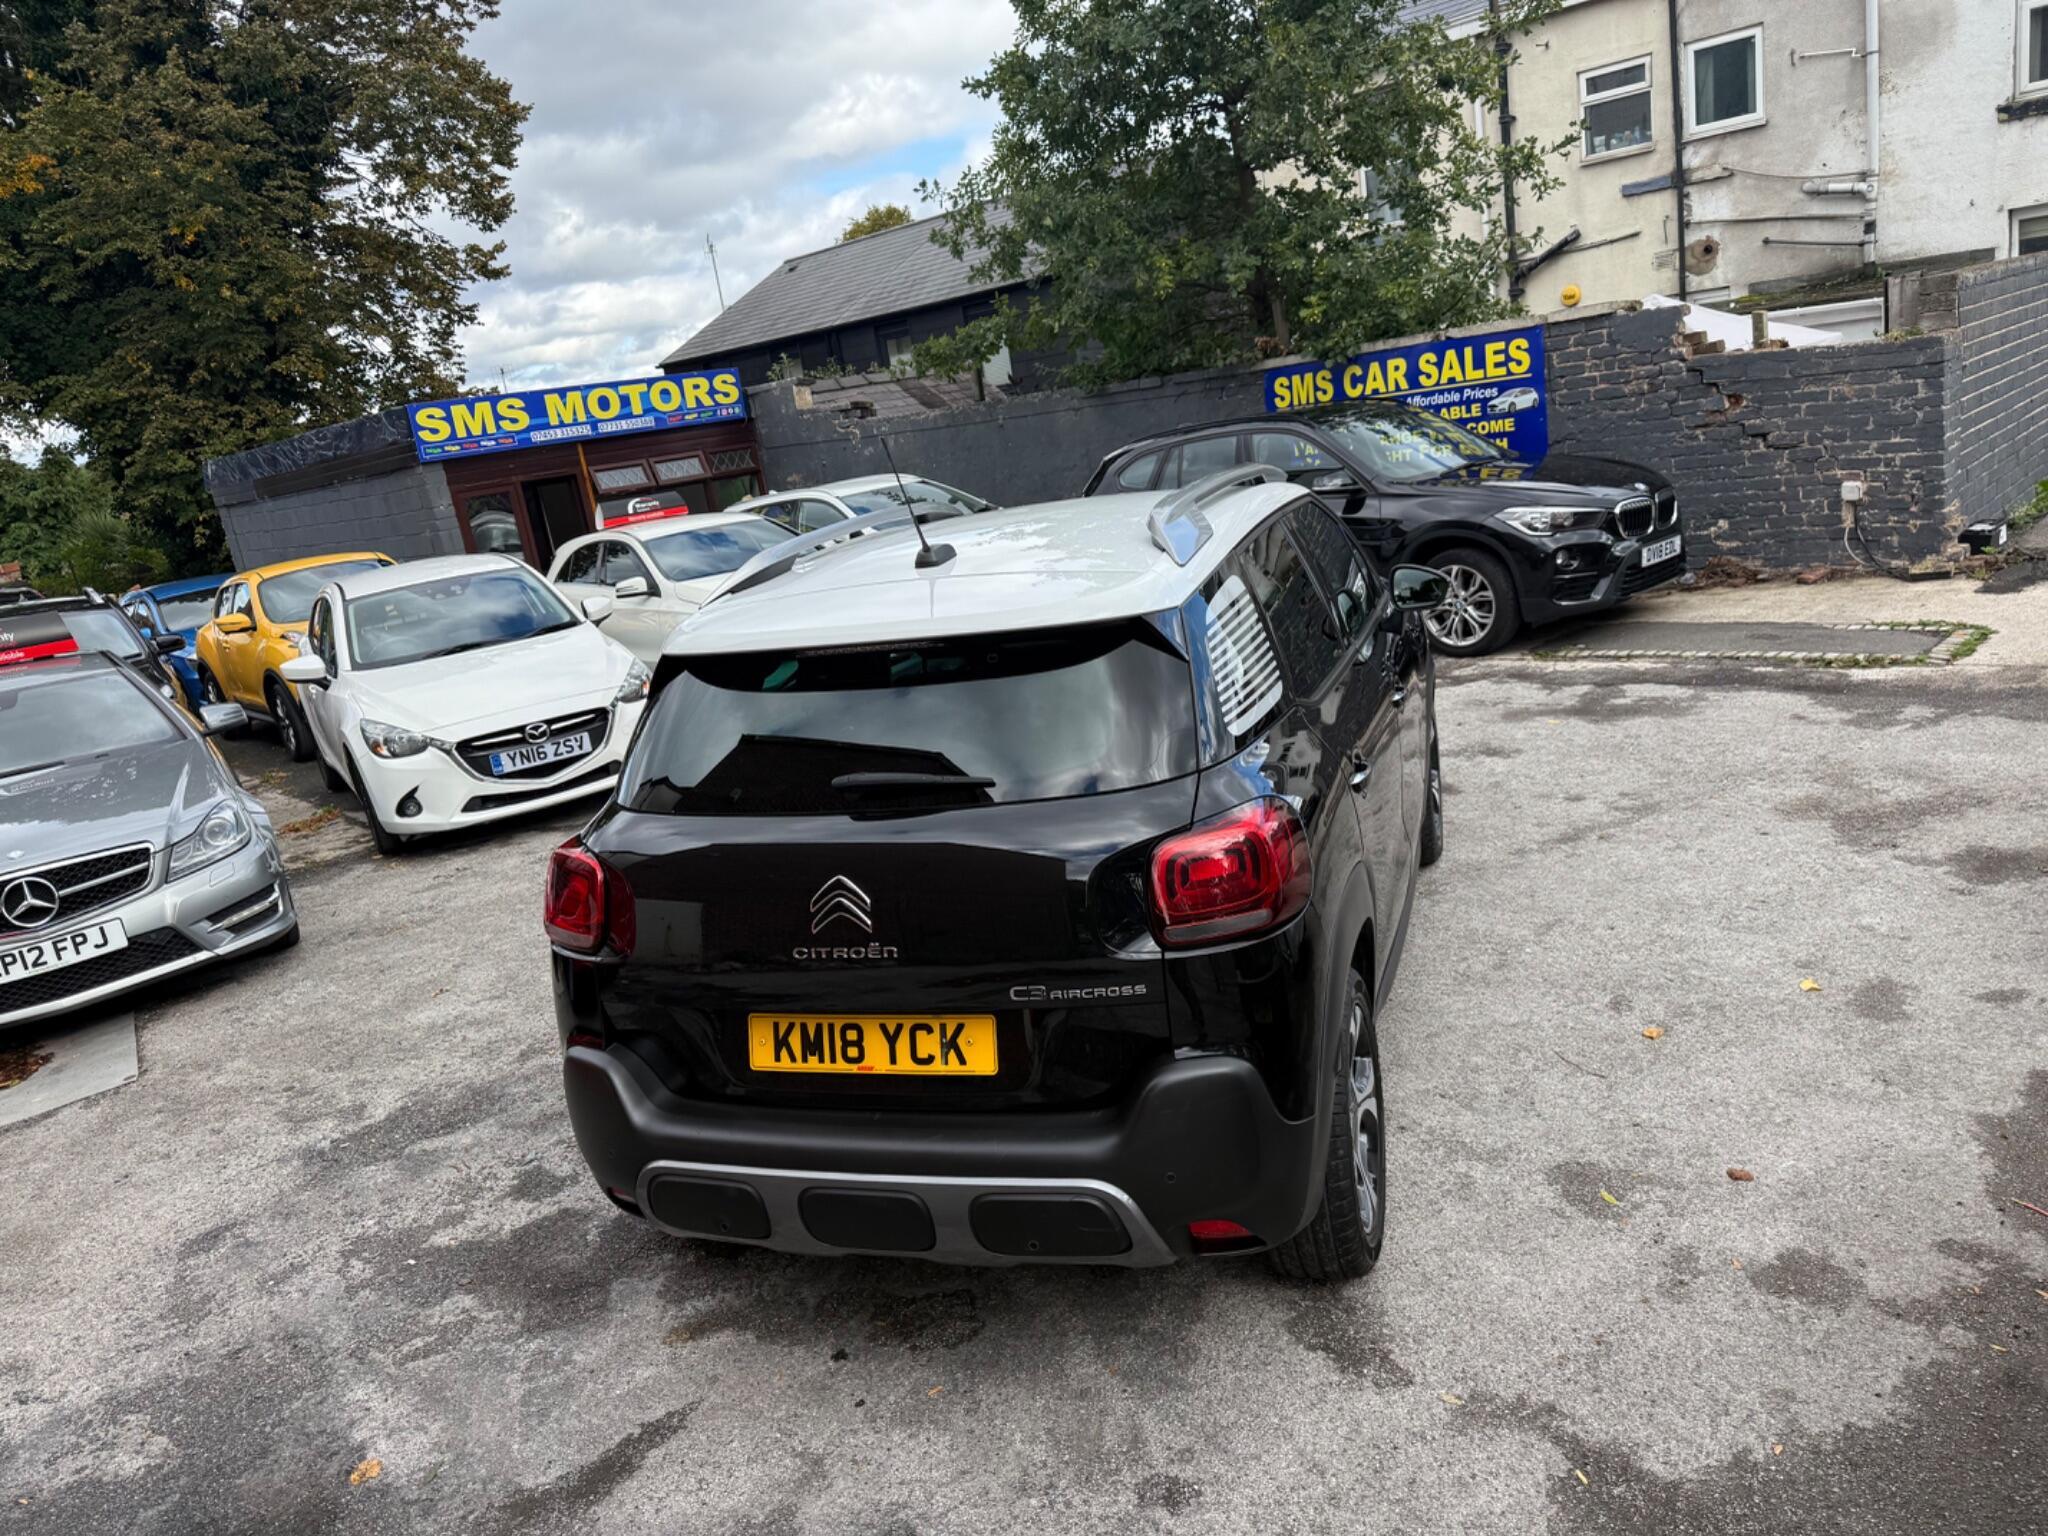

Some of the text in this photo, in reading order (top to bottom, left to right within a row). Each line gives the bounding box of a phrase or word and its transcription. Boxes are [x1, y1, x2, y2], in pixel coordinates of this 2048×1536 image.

[1273, 338, 1532, 409] SMS CAR SALES
[415, 373, 740, 442] SMS MOTORS
[1463, 387, 1499, 401] Prices
[507, 735, 584, 767] YN16 ZSV
[52, 926, 109, 961] FPJ
[1009, 984, 1147, 1001] C3 AIRCROSS
[772, 1021, 968, 1066] KM18 YCK
